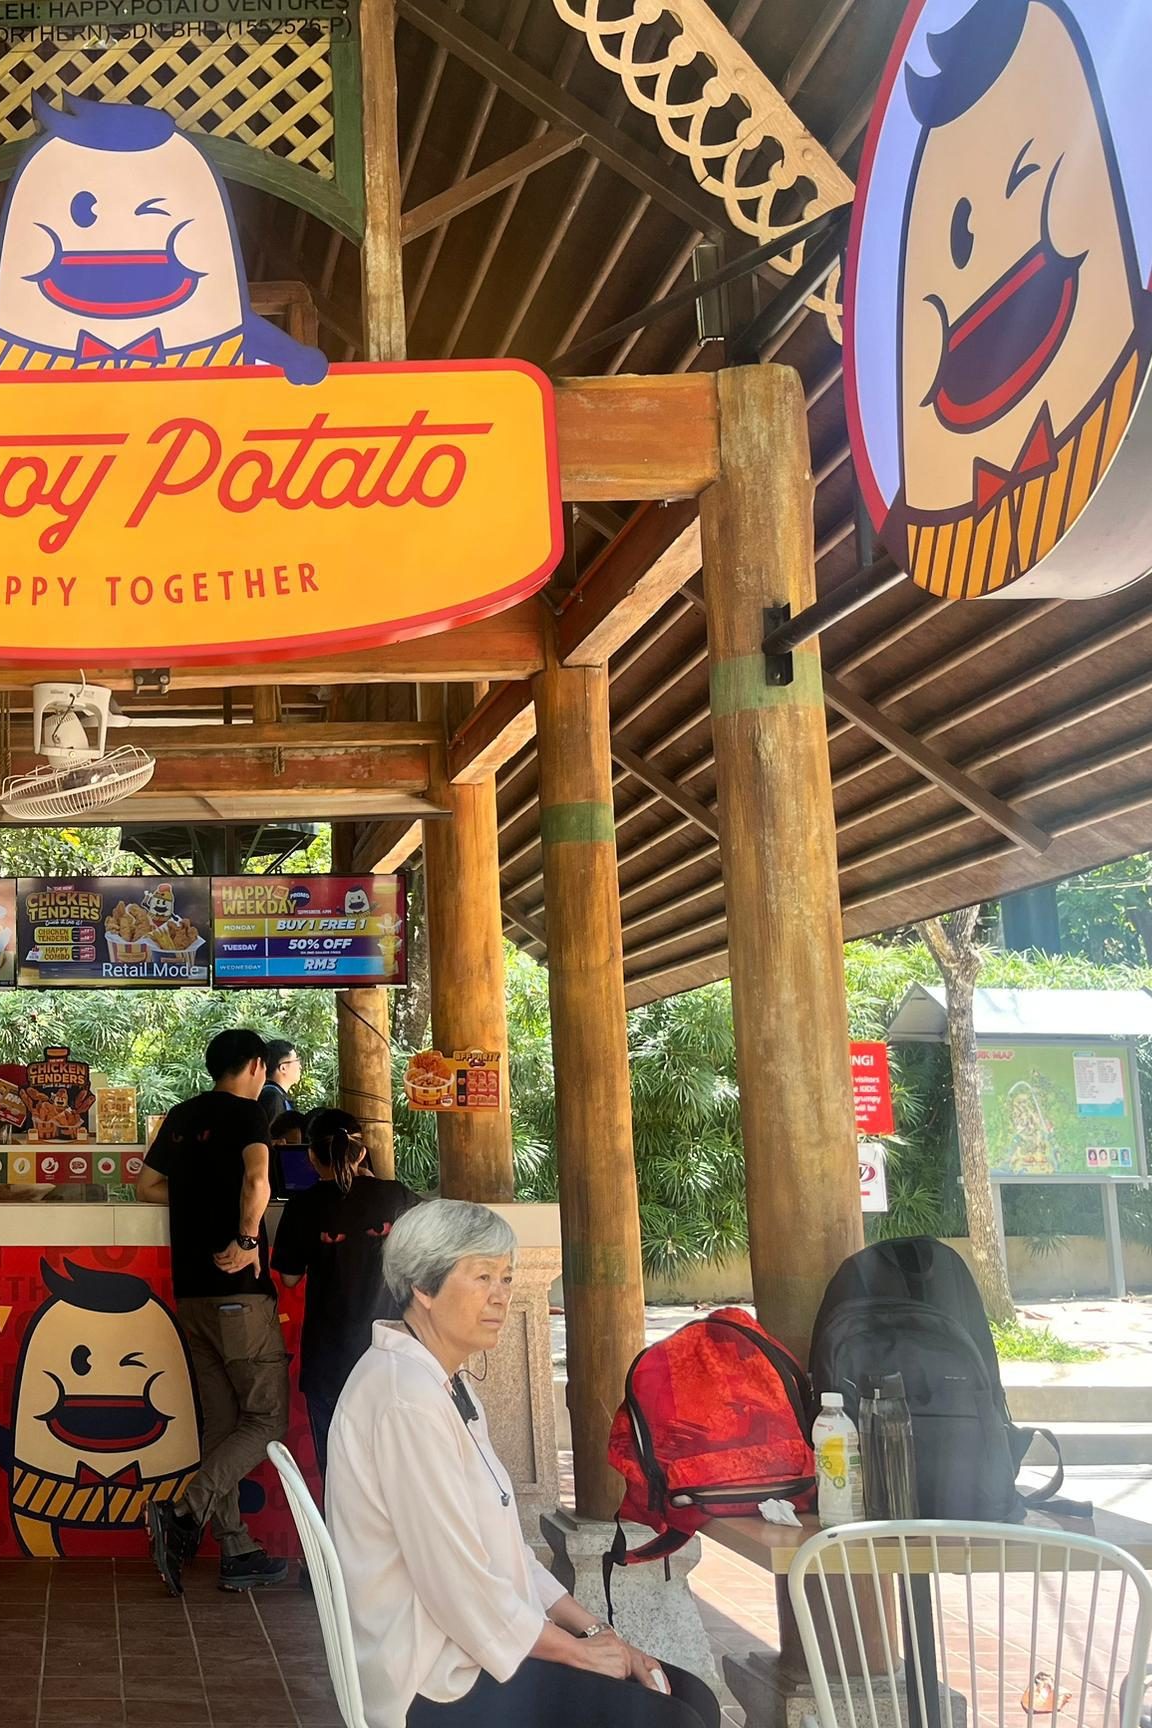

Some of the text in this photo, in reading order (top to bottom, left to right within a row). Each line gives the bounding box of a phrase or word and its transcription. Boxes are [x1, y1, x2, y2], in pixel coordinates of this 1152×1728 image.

[48, 1, 122, 18] HAPPY
[131, 0, 219, 15] POTATO
[223, 0, 349, 12] VENTURES
[125, 409, 494, 529] Potato
[105, 563, 320, 607] TOGETHER
[26, 892, 101, 907] CHICKEN
[222, 885, 274, 900] HAPPY
[28, 906, 100, 921] TENDERS
[222, 899, 297, 915] WEEKDAY
[276, 920, 307, 931] BUY
[318, 919, 356, 930] FREE
[358, 919, 368, 930] 1
[288, 939, 320, 950] 50%
[323, 938, 353, 950] OFF
[102, 962, 199, 978] Retail Mode
[303, 958, 339, 971] RM3
[29, 1065, 87, 1076] CHICKEN
[30, 1074, 85, 1085] TENDERS
